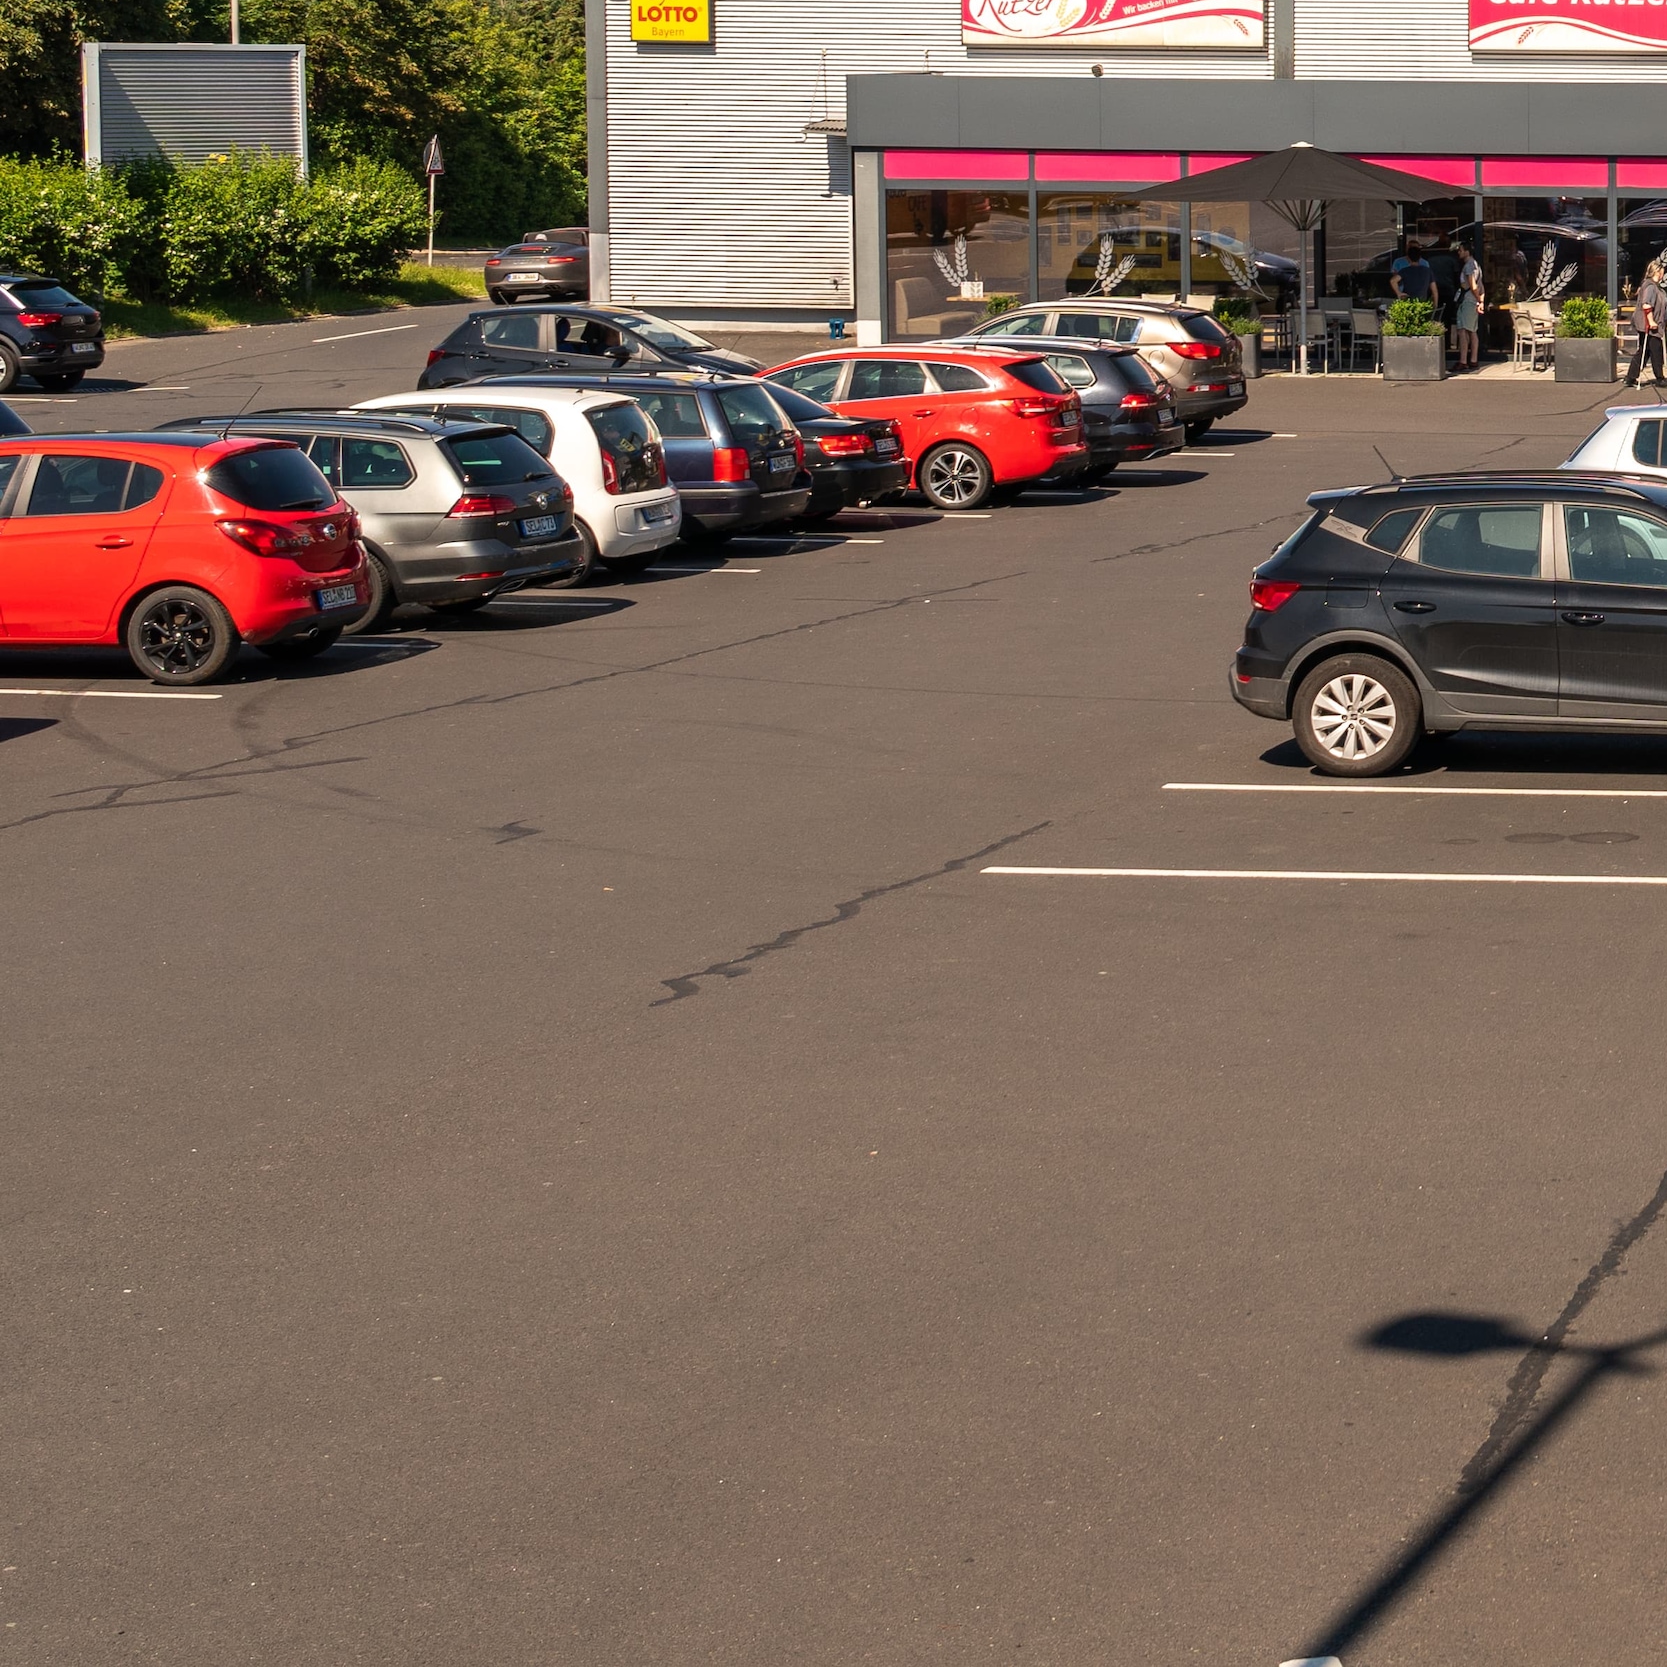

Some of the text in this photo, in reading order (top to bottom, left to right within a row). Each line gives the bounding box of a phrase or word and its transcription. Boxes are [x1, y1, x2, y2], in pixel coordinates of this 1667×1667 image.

[638, 6, 698, 23] LOTTO
[1122, 4, 1136, 15] Wir
[1137, 0, 1164, 12] backen
[652, 26, 685, 38] Bayern
